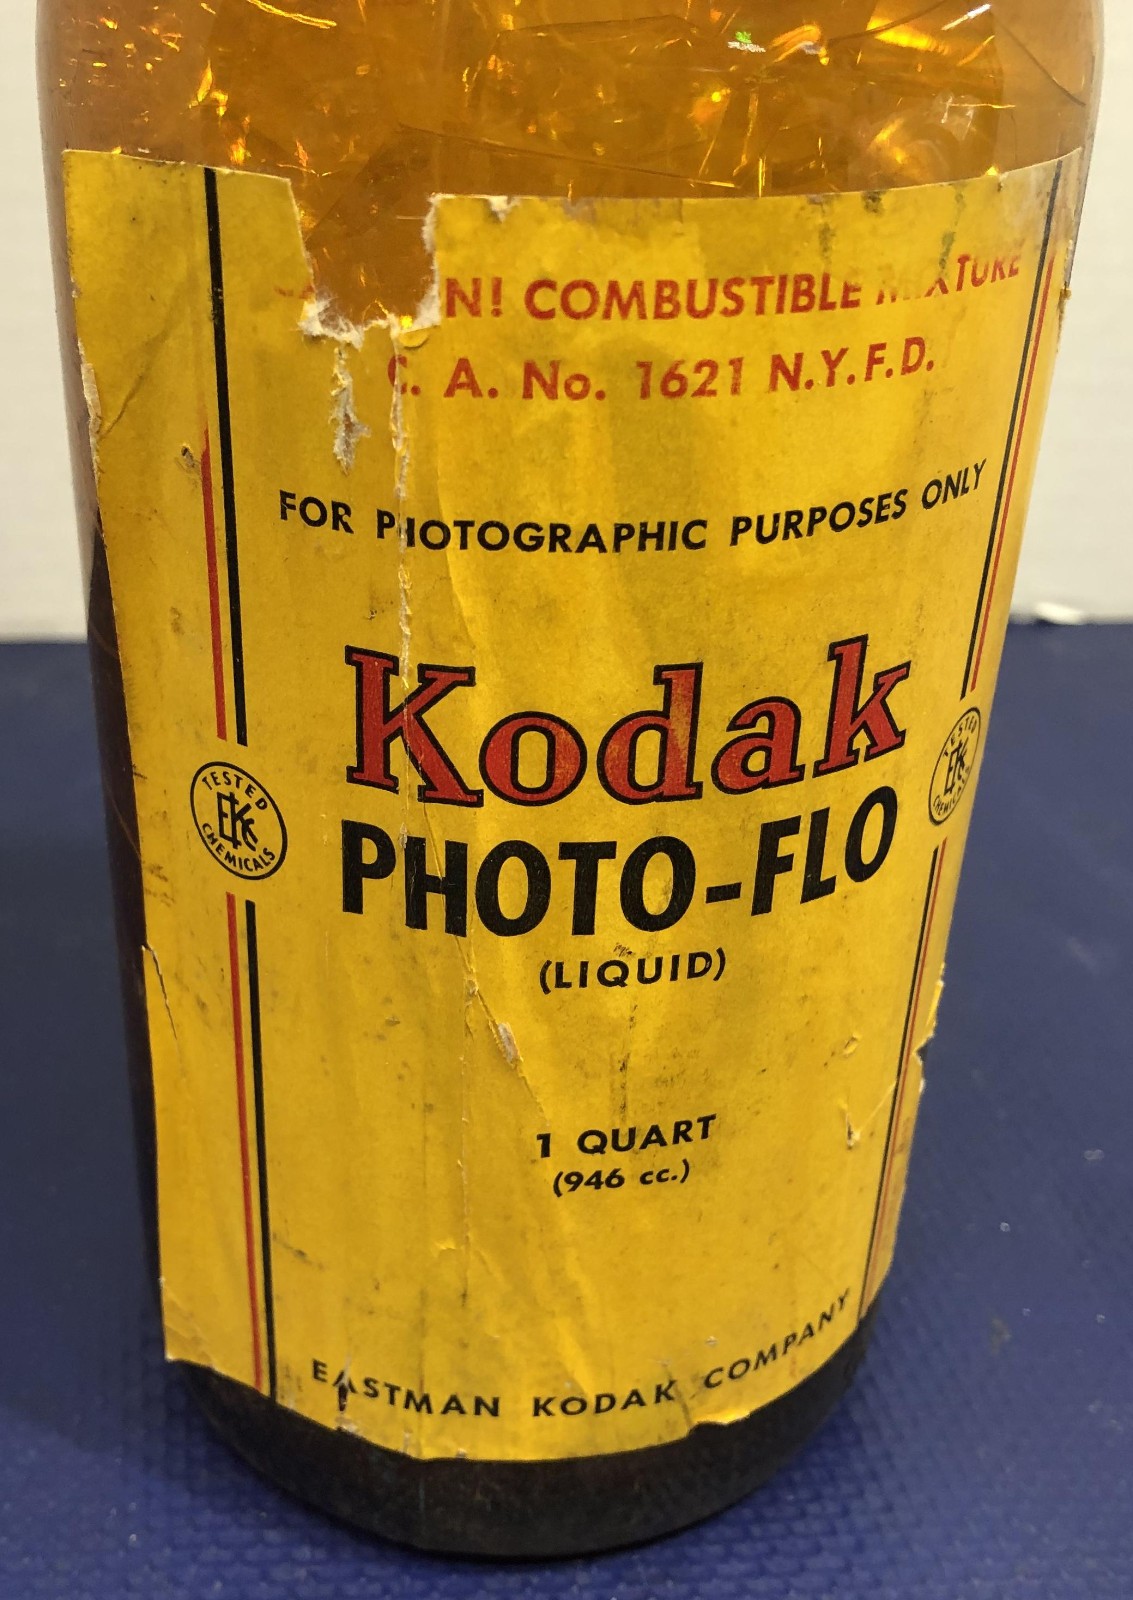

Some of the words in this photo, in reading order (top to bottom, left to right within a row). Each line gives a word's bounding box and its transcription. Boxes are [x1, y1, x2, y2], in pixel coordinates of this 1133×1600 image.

[523, 272, 862, 321] COMBUSTIBLE
[876, 254, 1021, 305] XTURE
[443, 357, 499, 399] A.
[521, 360, 606, 401] No.
[636, 356, 744, 398] 1621
[769, 336, 934, 393] N.Y.F.D.
[280, 490, 353, 534] FOR
[729, 489, 908, 547] PURPOSES
[922, 459, 987, 511] ONLY
[345, 634, 911, 808] Kodak
[202, 771, 268, 811] TESTED
[202, 823, 276, 872] CHEMICALS
[342, 786, 899, 938] PHOTO-FLO
[540, 947, 728, 995] (LIQUID)
[536, 1133, 552, 1159] 1
[577, 1114, 718, 1157] QUART
[552, 1169, 624, 1197] (946
[639, 1158, 691, 1185] cc.)
[312, 1358, 500, 1417] EASTMAN
[532, 1380, 678, 1419] KODAK
[704, 1288, 852, 1390] COMPANY
